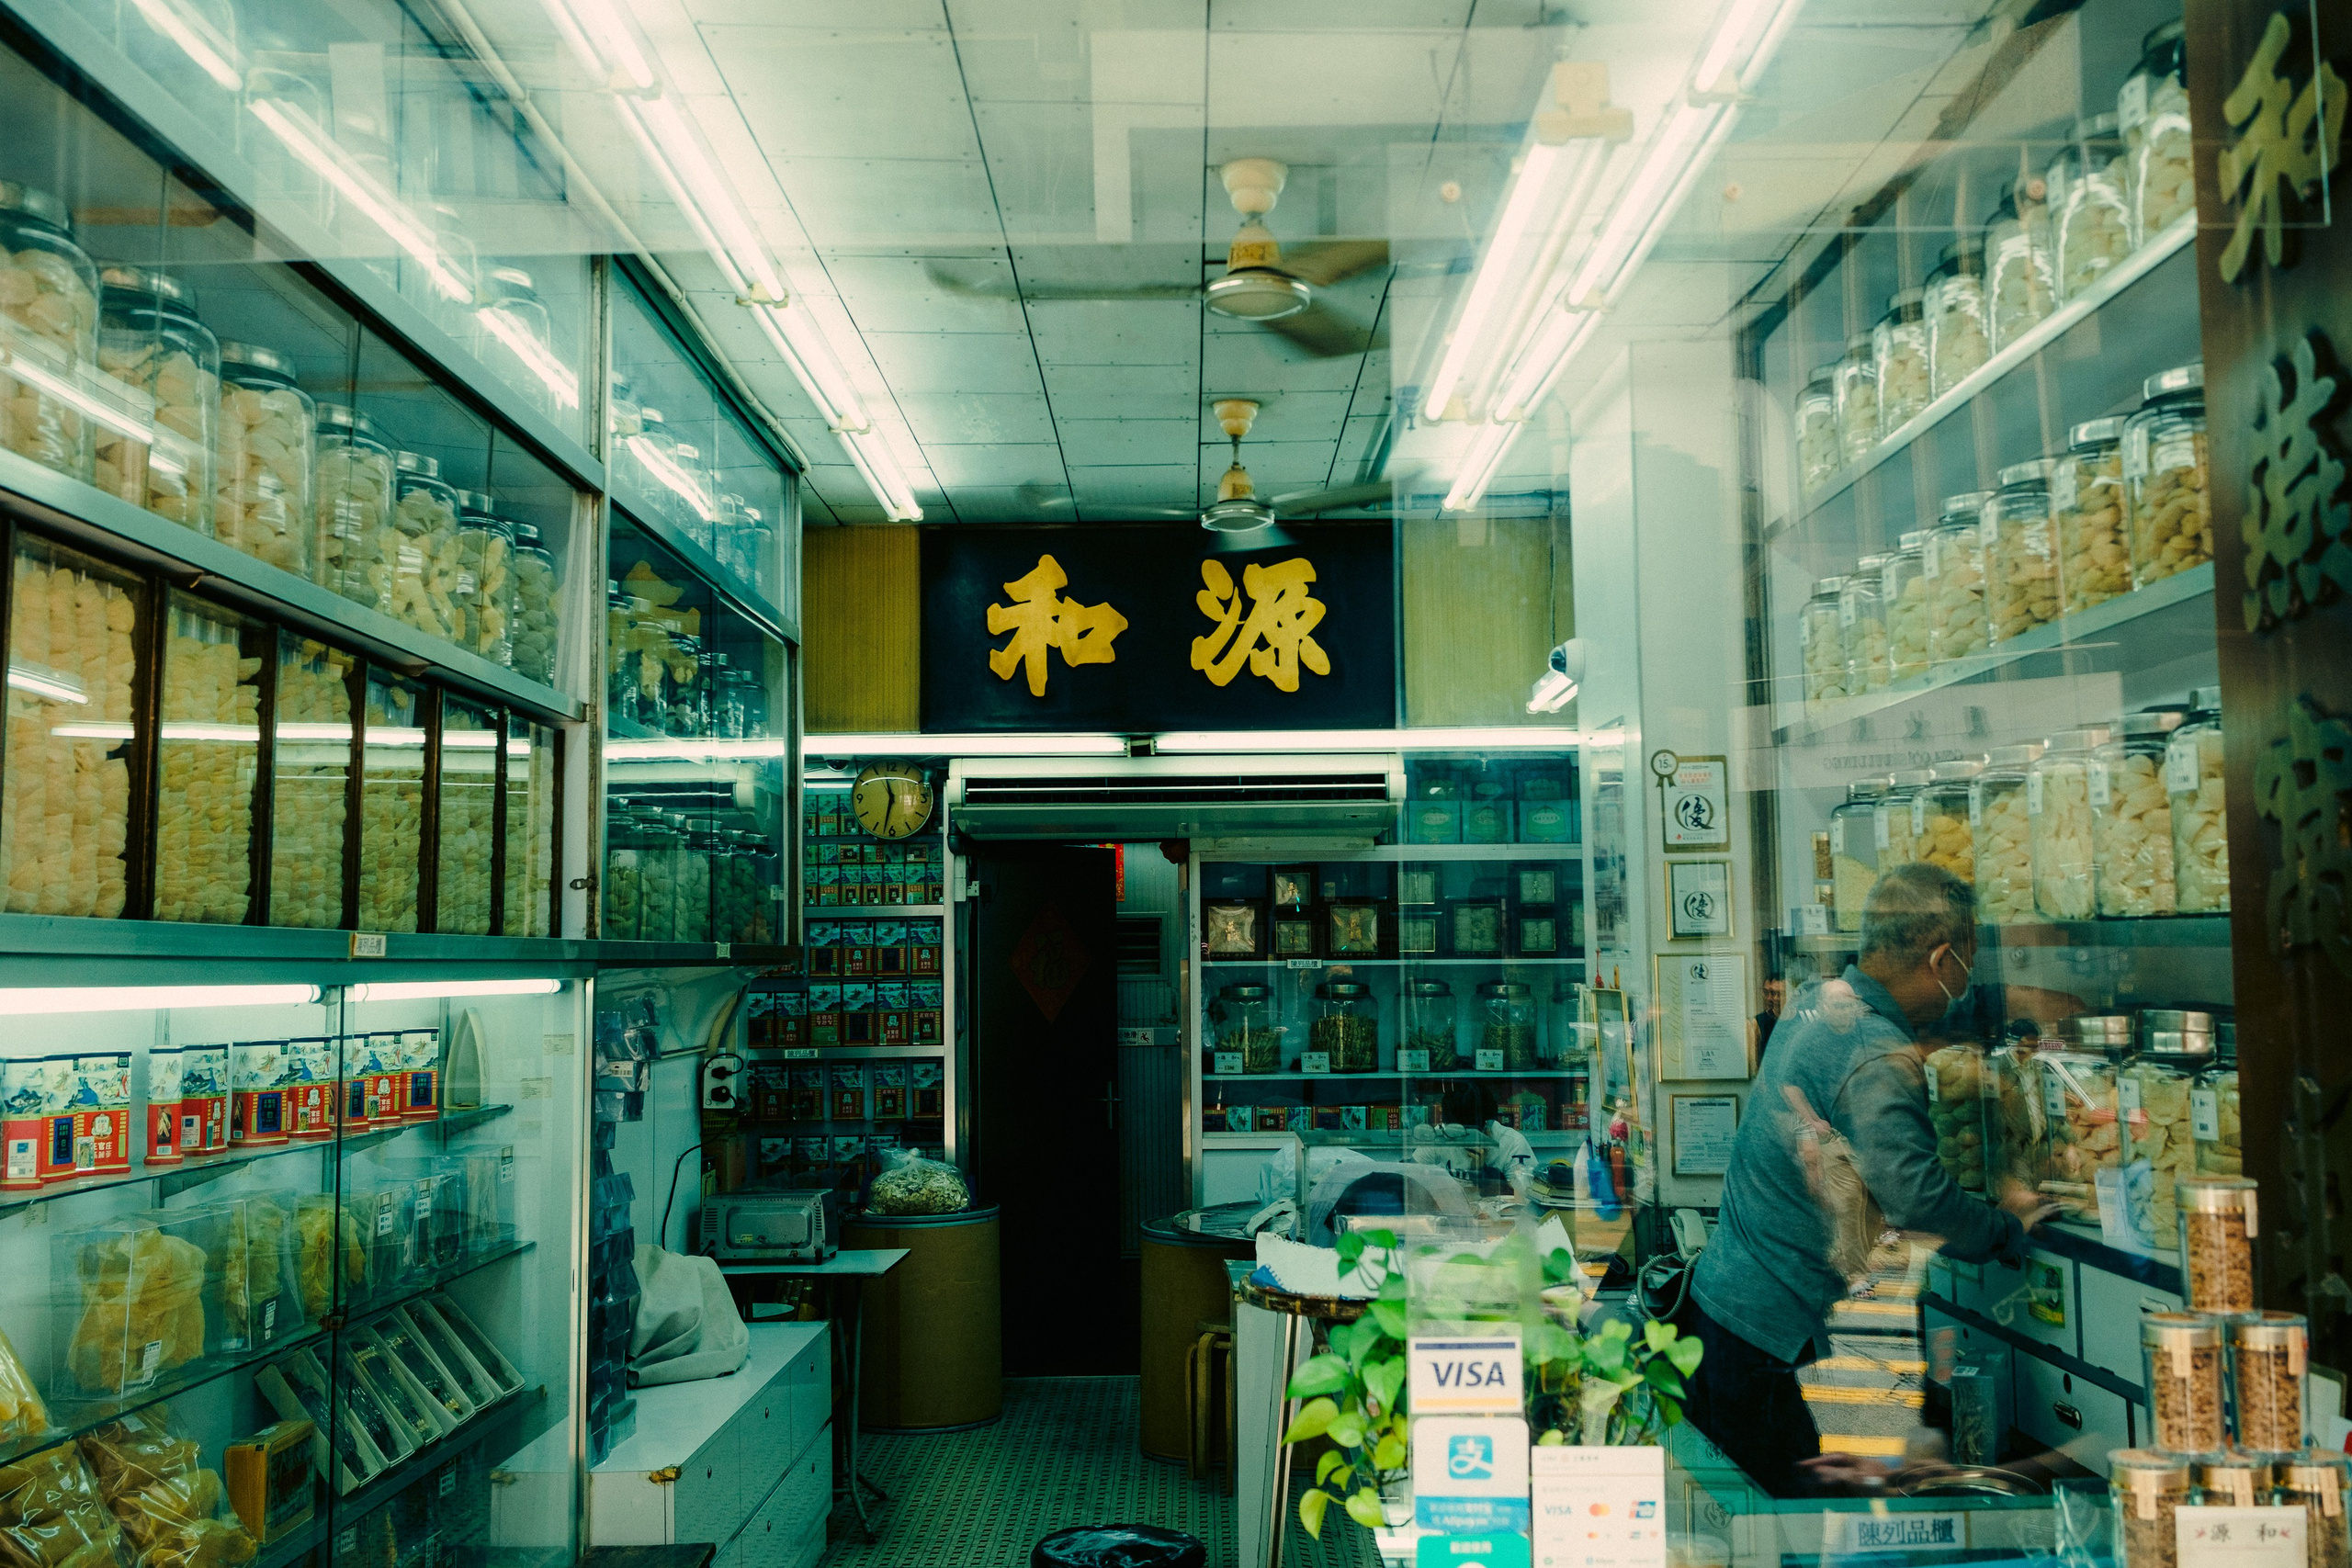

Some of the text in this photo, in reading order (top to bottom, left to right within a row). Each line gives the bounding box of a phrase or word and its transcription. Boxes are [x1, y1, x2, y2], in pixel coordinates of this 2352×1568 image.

[887, 761, 898, 773] 12
[855, 794, 864, 805] 9
[920, 794, 928, 805] 3
[888, 825, 897, 837] 6
[1432, 1361, 1505, 1386] VISA
[1544, 1505, 1572, 1516] VISA
[1858, 1518, 1956, 1547] 陳列品櫃
